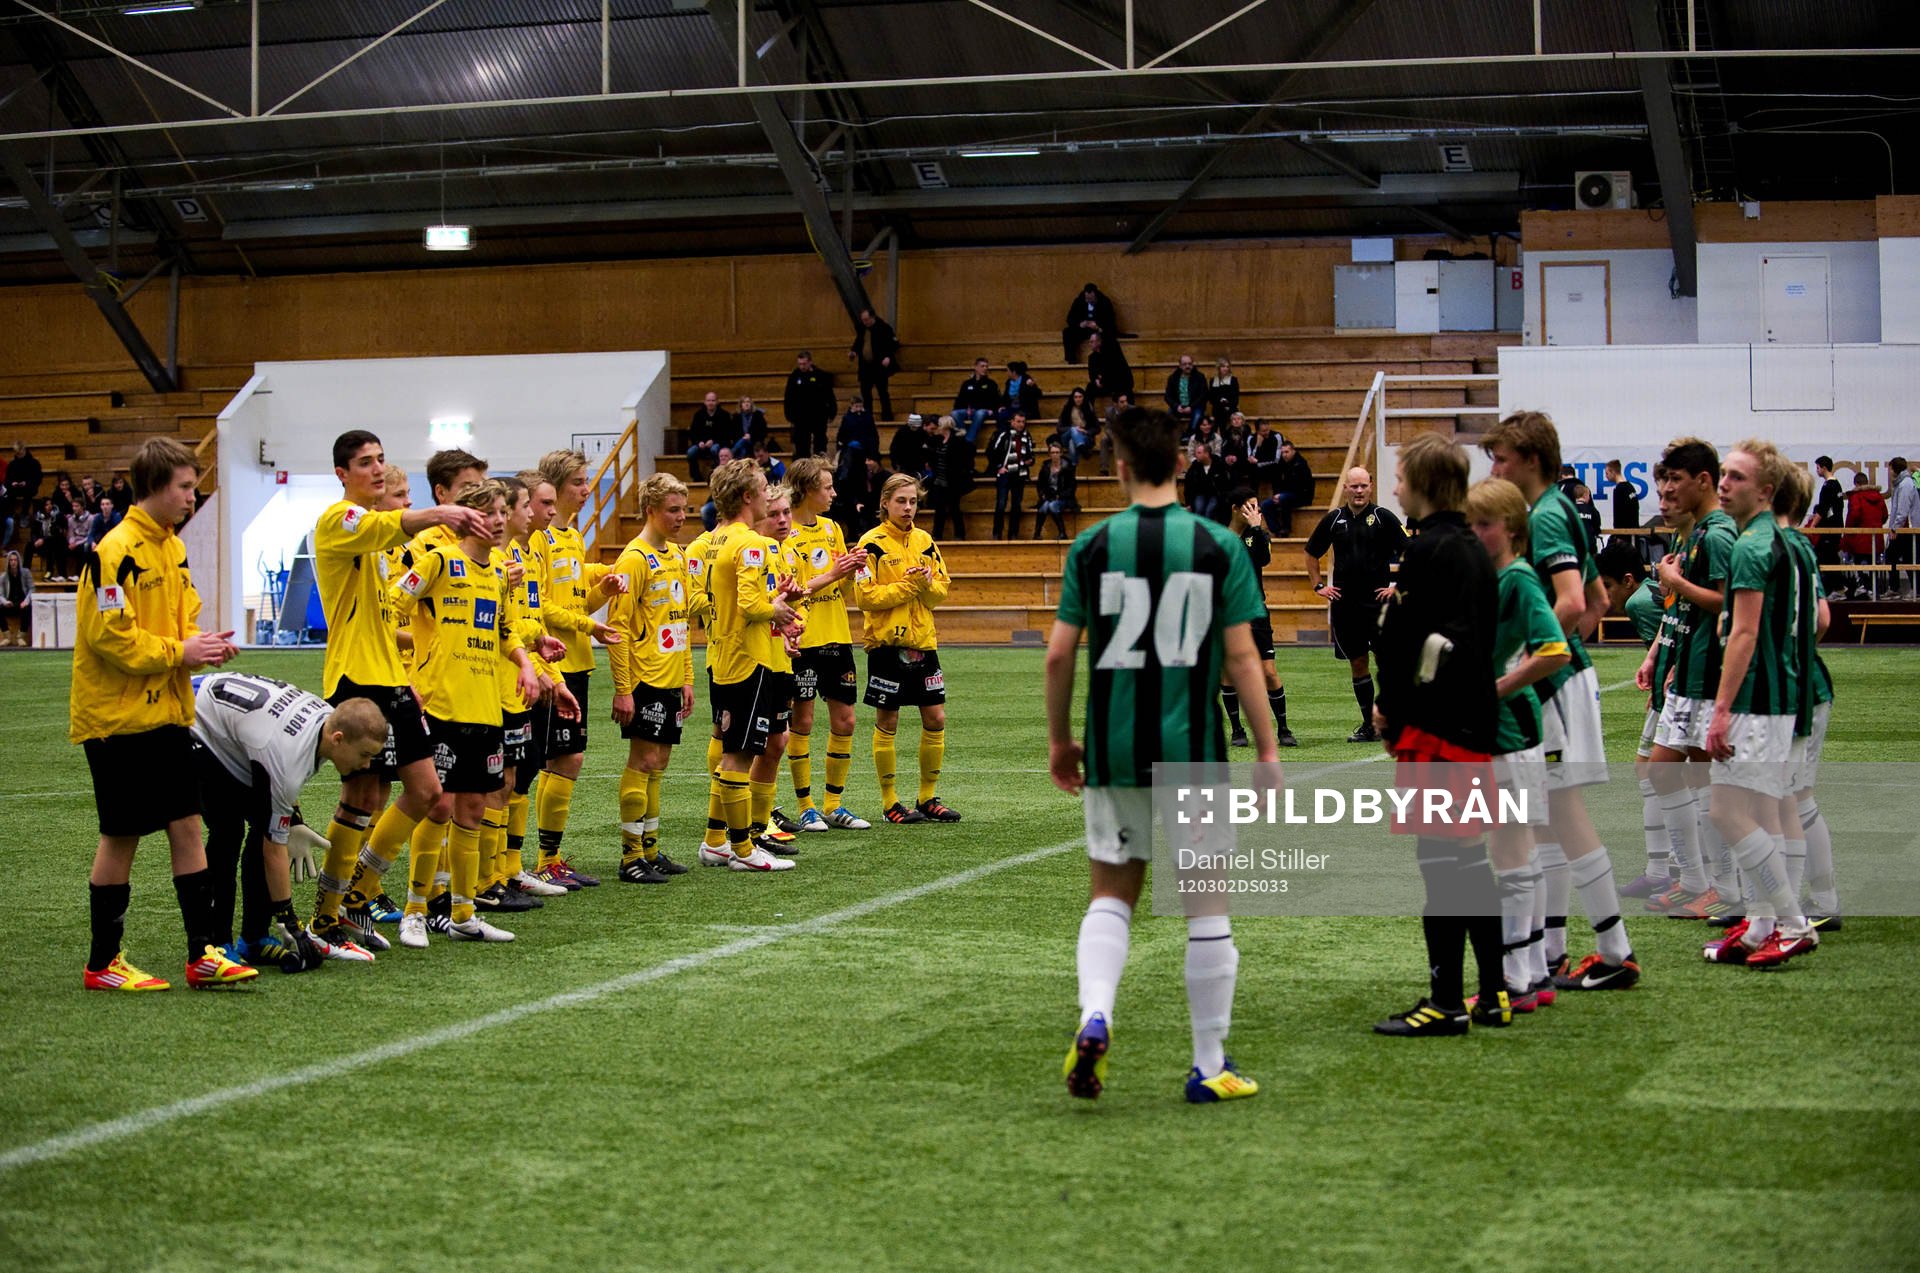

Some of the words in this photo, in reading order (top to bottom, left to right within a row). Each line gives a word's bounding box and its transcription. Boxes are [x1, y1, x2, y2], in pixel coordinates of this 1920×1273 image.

[1444, 147, 1466, 164] E
[917, 164, 940, 181] E
[177, 200, 199, 215] D
[1562, 461, 1649, 500] IPS
[476, 611, 494, 623] SAS
[1094, 570, 1213, 670] 20
[894, 625, 907, 638] 17
[878, 694, 886, 704] 2
[556, 728, 571, 741] 18
